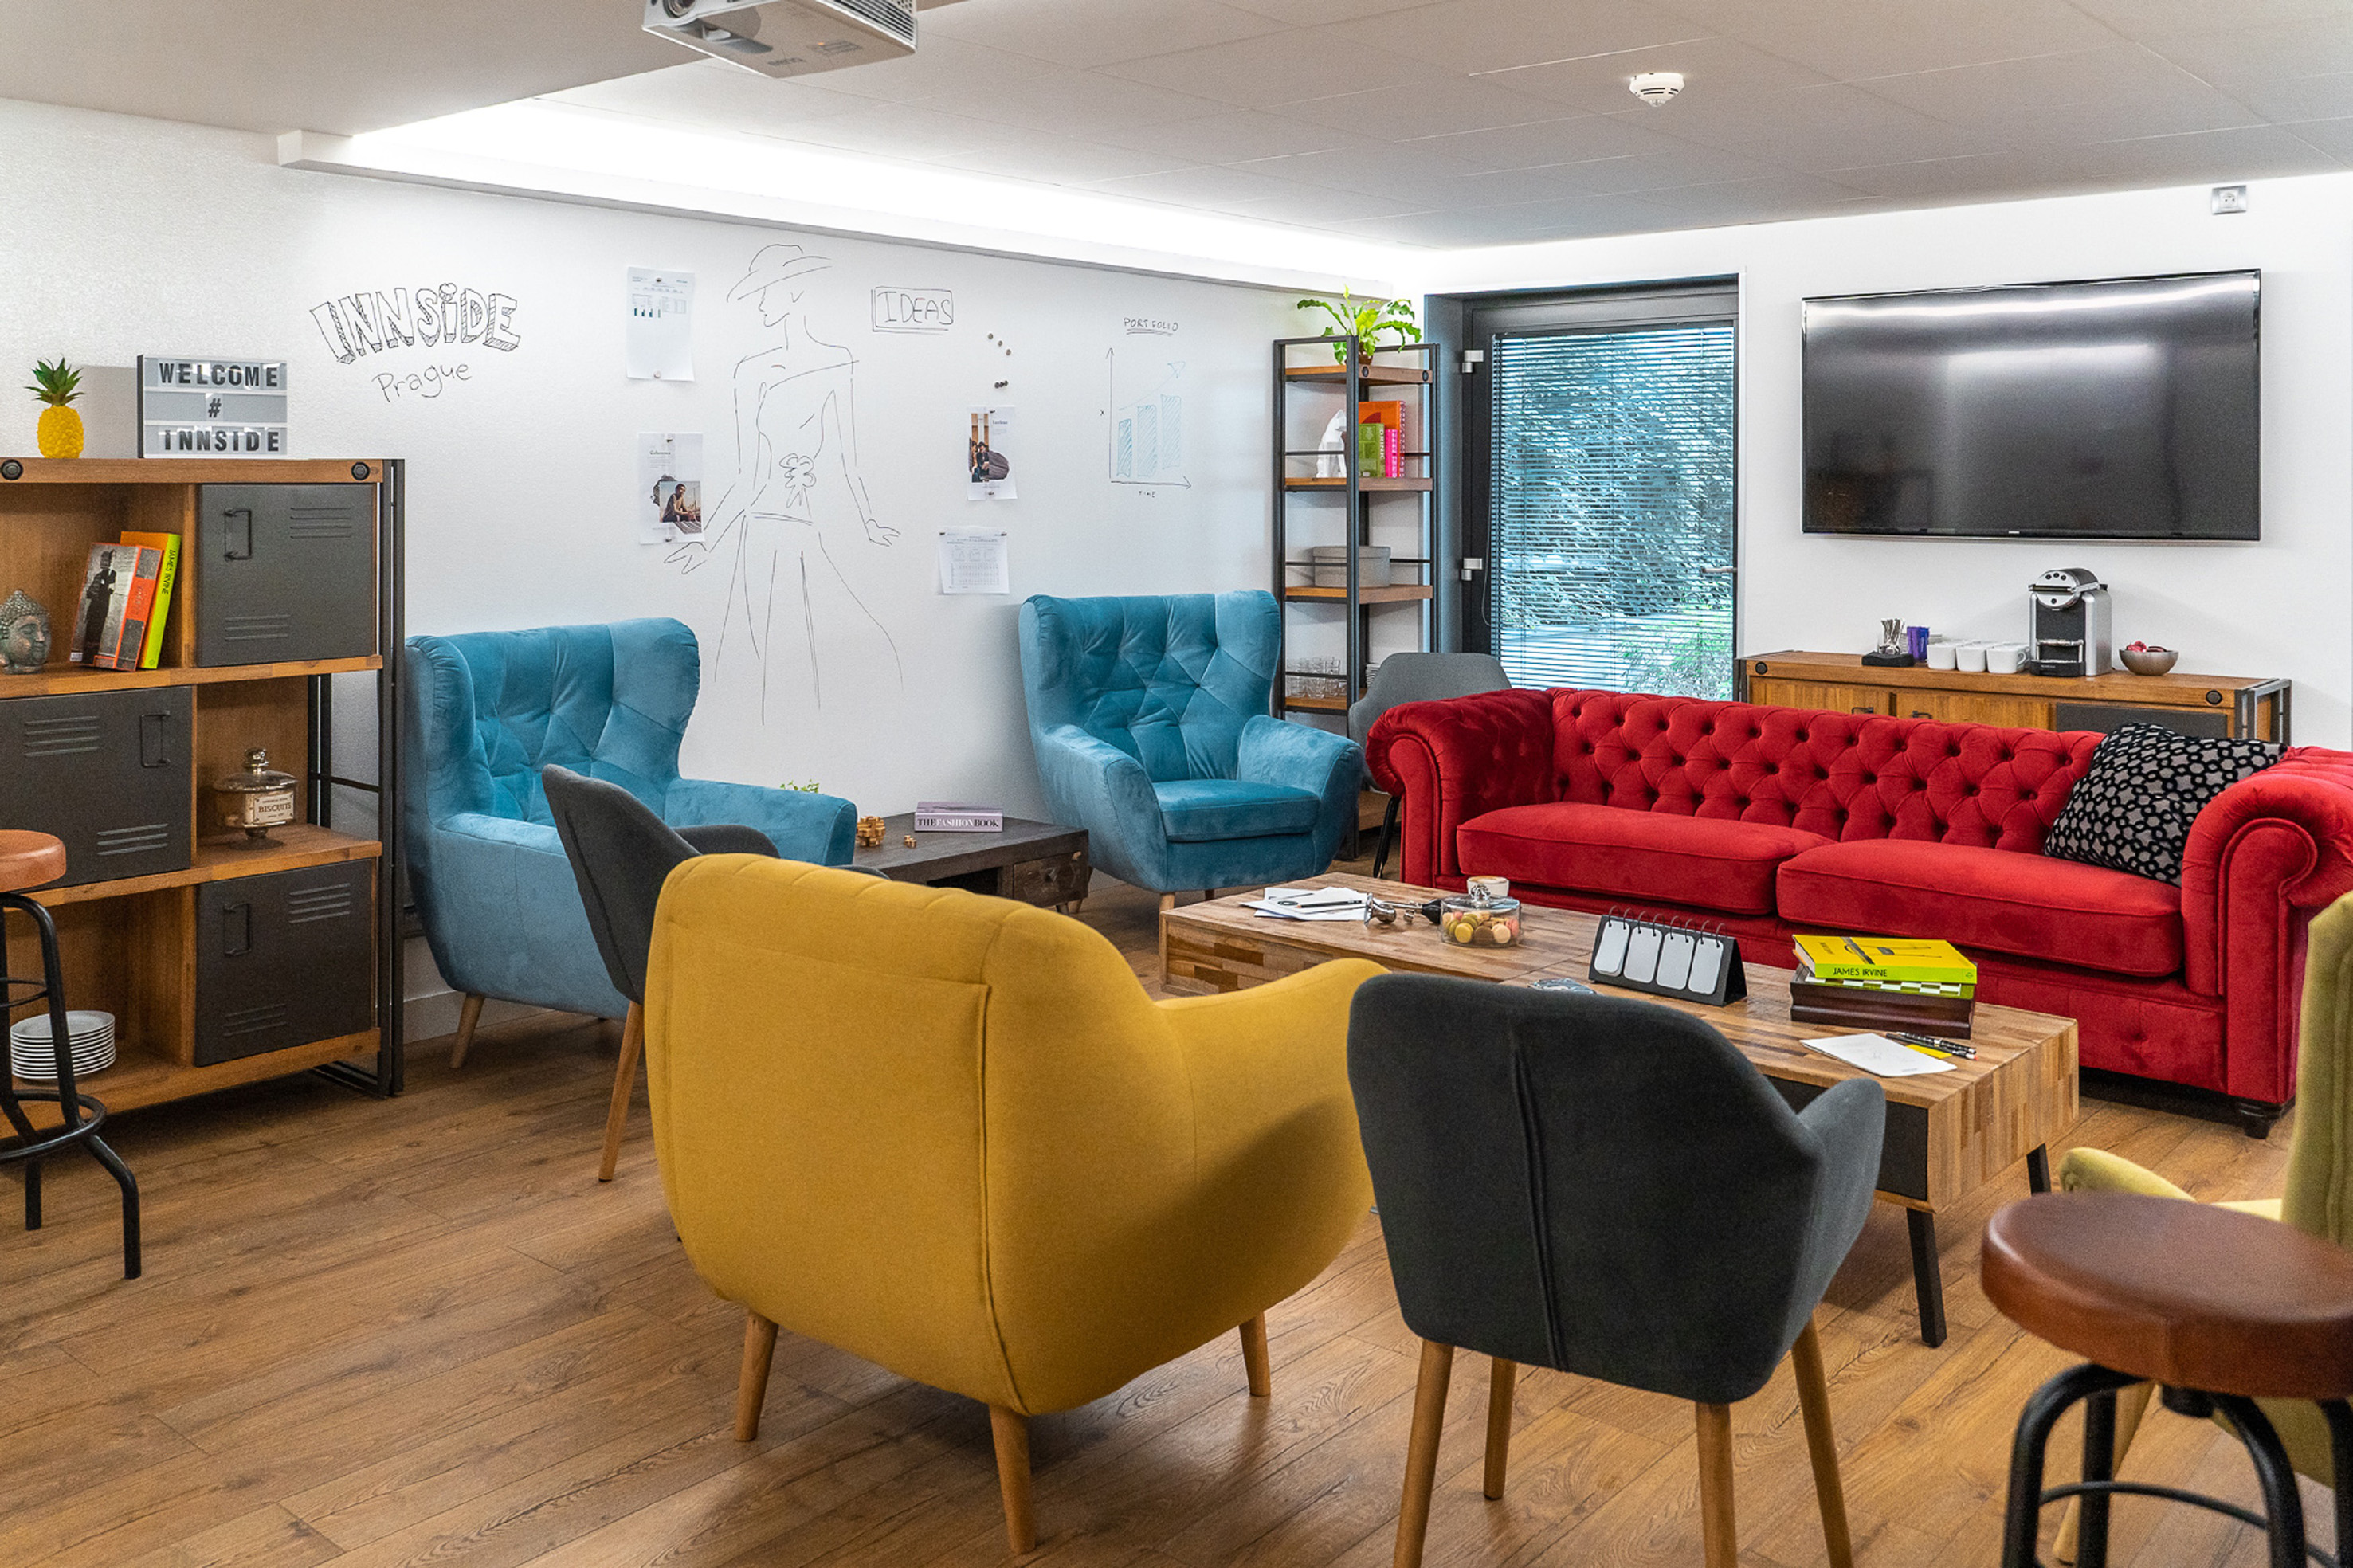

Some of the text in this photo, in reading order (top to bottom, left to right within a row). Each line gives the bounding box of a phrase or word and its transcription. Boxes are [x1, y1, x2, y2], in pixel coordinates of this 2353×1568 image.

[876, 291, 954, 325] IDEAS
[1124, 317, 1178, 331] PORTFOLIO
[159, 363, 277, 387] WELCOME
[371, 364, 472, 402] Prague
[208, 398, 222, 418] #
[164, 429, 279, 452] INNSIDE
[166, 549, 176, 571] JAMES
[258, 802, 292, 813] BISCUITS
[937, 818, 974, 827] FASHION
[1833, 967, 1888, 977] JAMES IRVINE
